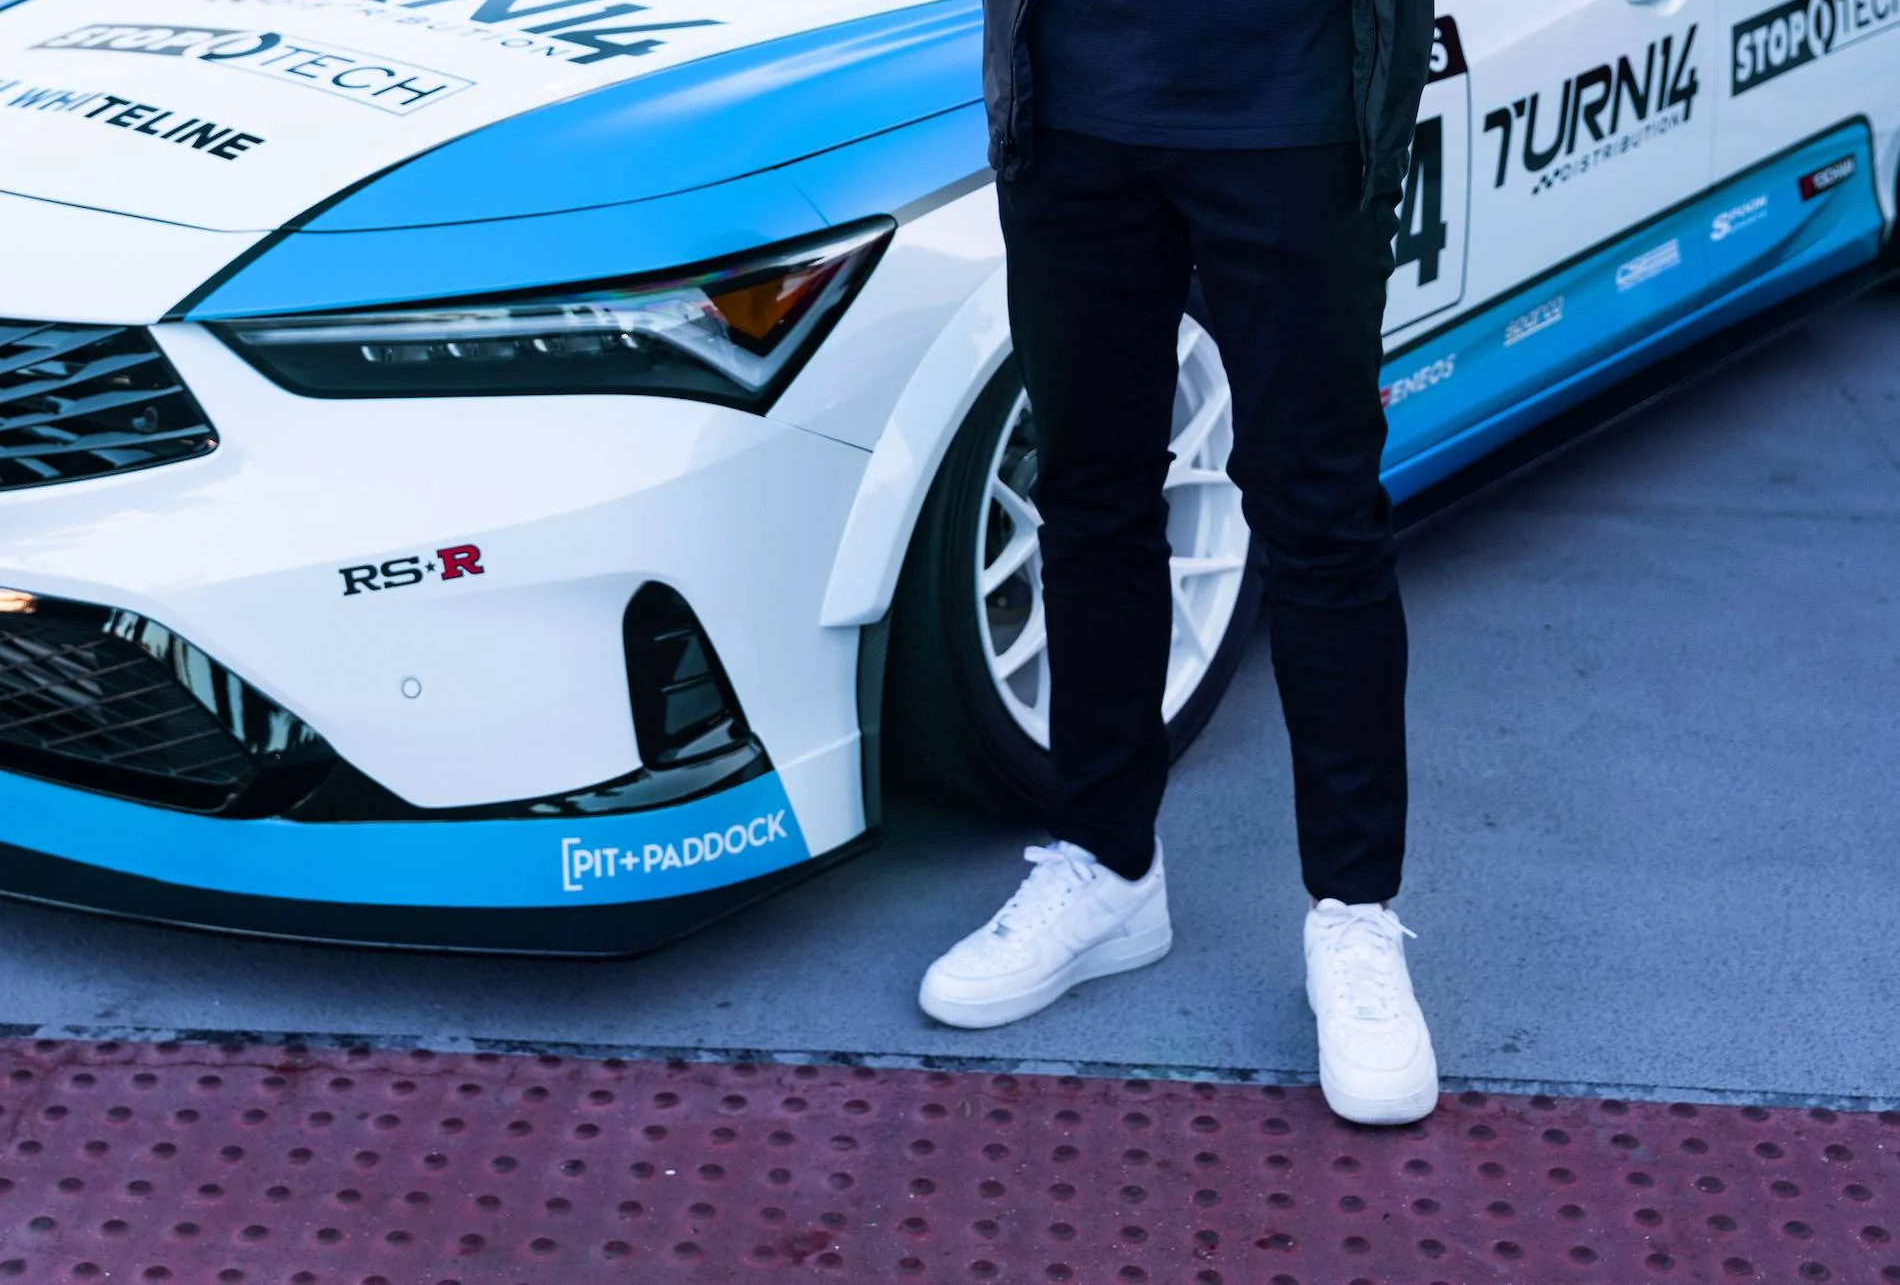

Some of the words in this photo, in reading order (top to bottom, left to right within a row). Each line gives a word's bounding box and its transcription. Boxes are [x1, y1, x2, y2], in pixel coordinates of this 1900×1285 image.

[1735, 9, 1806, 83] STOP
[7, 86, 267, 162] WHITELINE
[1483, 22, 1700, 190] TURN14
[1388, 352, 1457, 406] ENEOS
